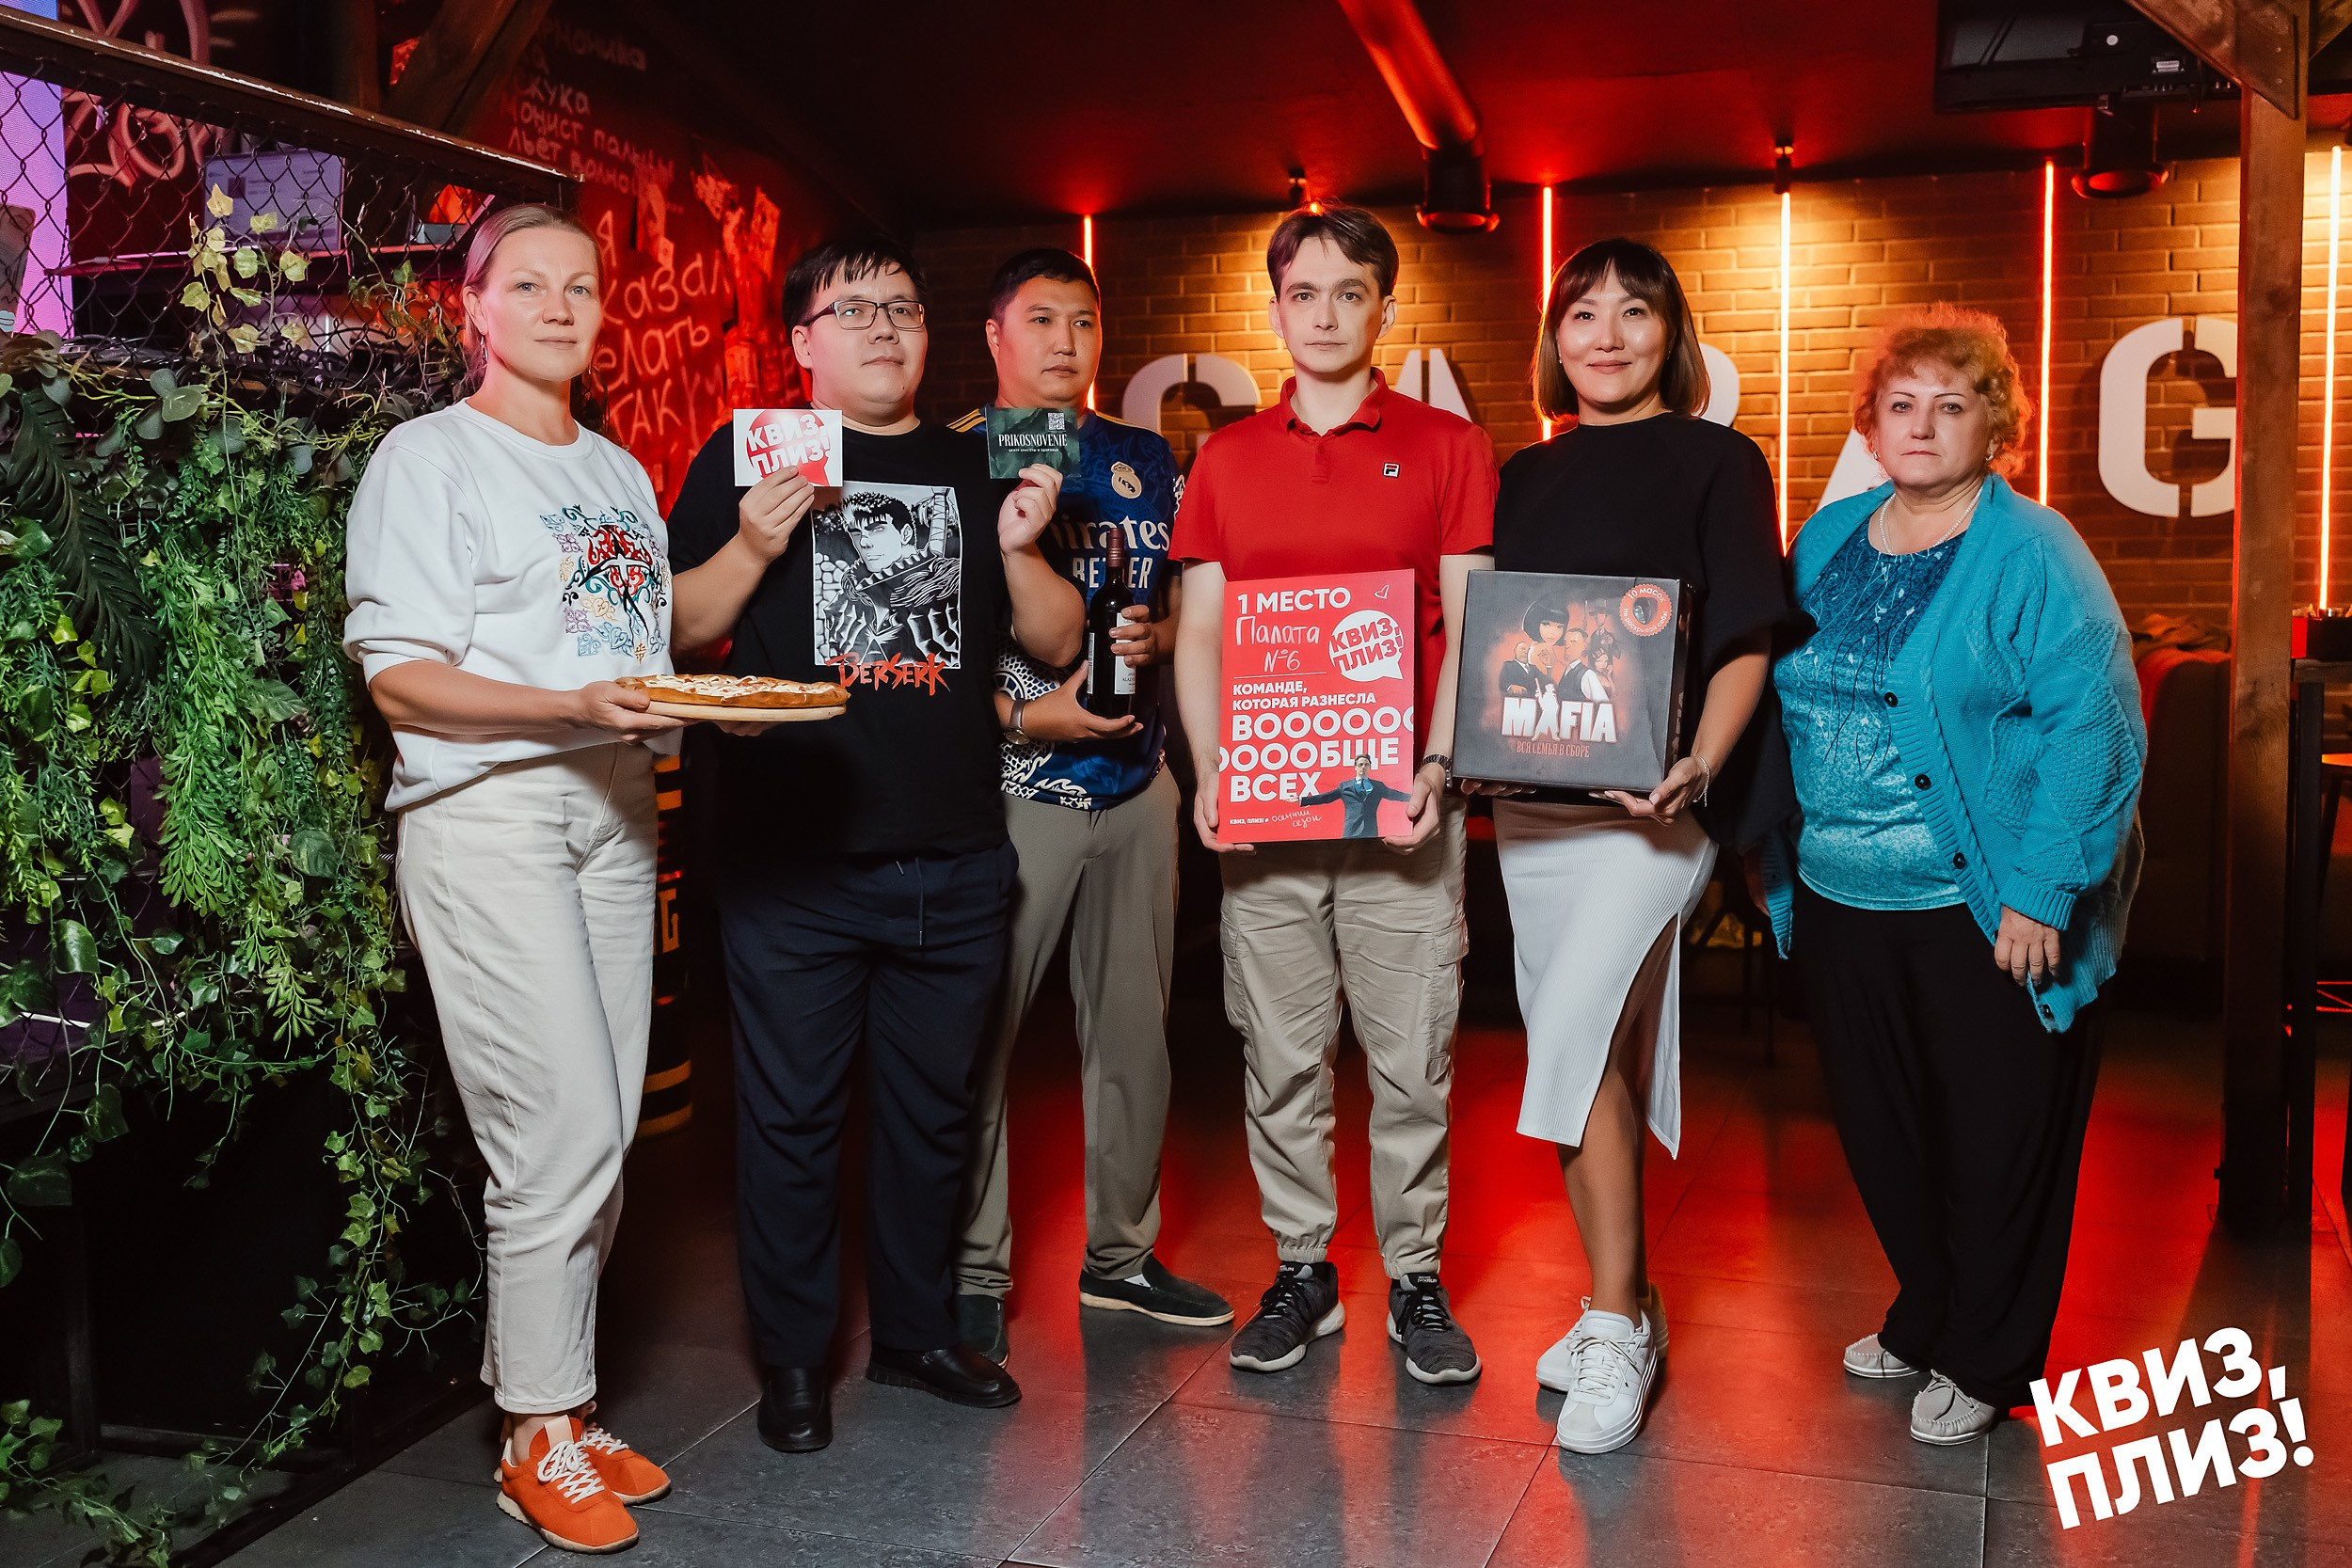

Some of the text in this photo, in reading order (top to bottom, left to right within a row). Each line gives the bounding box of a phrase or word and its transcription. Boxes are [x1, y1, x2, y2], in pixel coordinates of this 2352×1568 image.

[602, 248, 731, 325] казал
[592, 316, 710, 391] елать
[747, 414, 826, 451] КВИЗ,
[998, 434, 1068, 447] PRIKOSNOVENIE
[751, 436, 830, 477] ПЛИЗ!
[1073, 557, 1153, 589] BEER
[1237, 587, 1351, 614] 1 МЕСТО
[1628, 590, 1638, 599] 10
[1235, 616, 1320, 646] Палата
[1330, 617, 1400, 653] КВИЗ,
[1333, 636, 1403, 672] ПЛИЗ!
[1232, 681, 1308, 696] КОМАНДЕ,
[1232, 693, 1376, 711] КОТОРАЯ РАЗНЕСЛА
[1502, 694, 1617, 743] MAFIA
[1517, 741, 1590, 758] ВСЯ СЕМЬЯ В СБОРЕ
[1231, 771, 1322, 802] ВСЕХ
